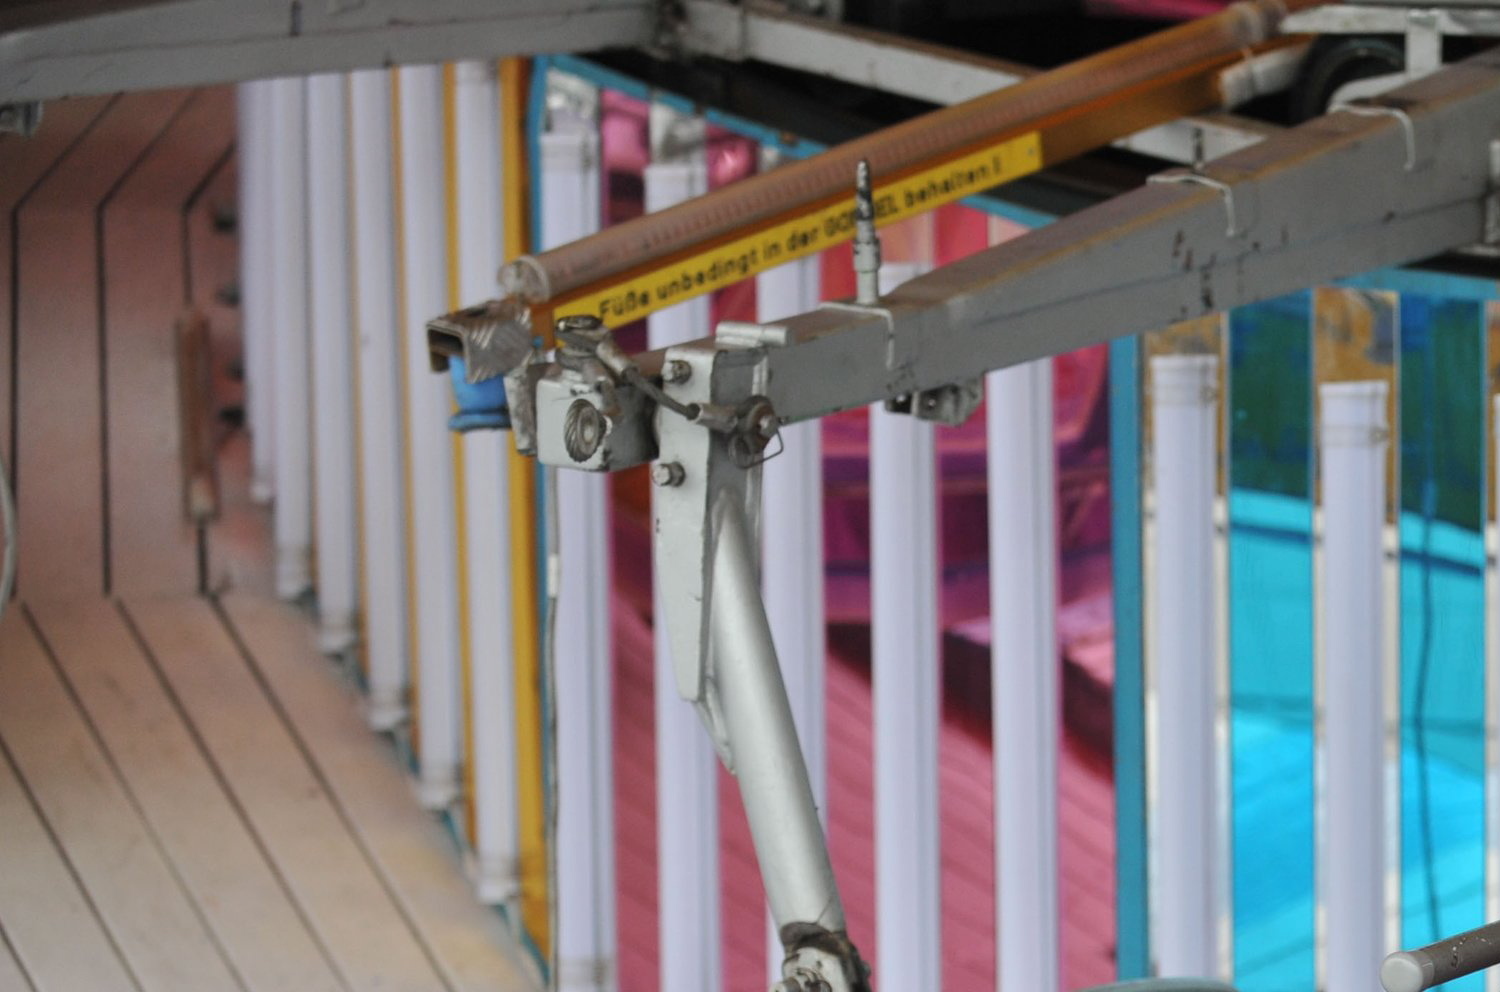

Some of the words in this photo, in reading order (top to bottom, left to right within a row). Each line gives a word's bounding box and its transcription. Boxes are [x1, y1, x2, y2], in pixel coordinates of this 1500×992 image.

[598, 290, 650, 316] Füße
[656, 248, 759, 299] unbedingt
[763, 241, 782, 260] in
[786, 227, 819, 252] der
[904, 164, 990, 208] behalten
